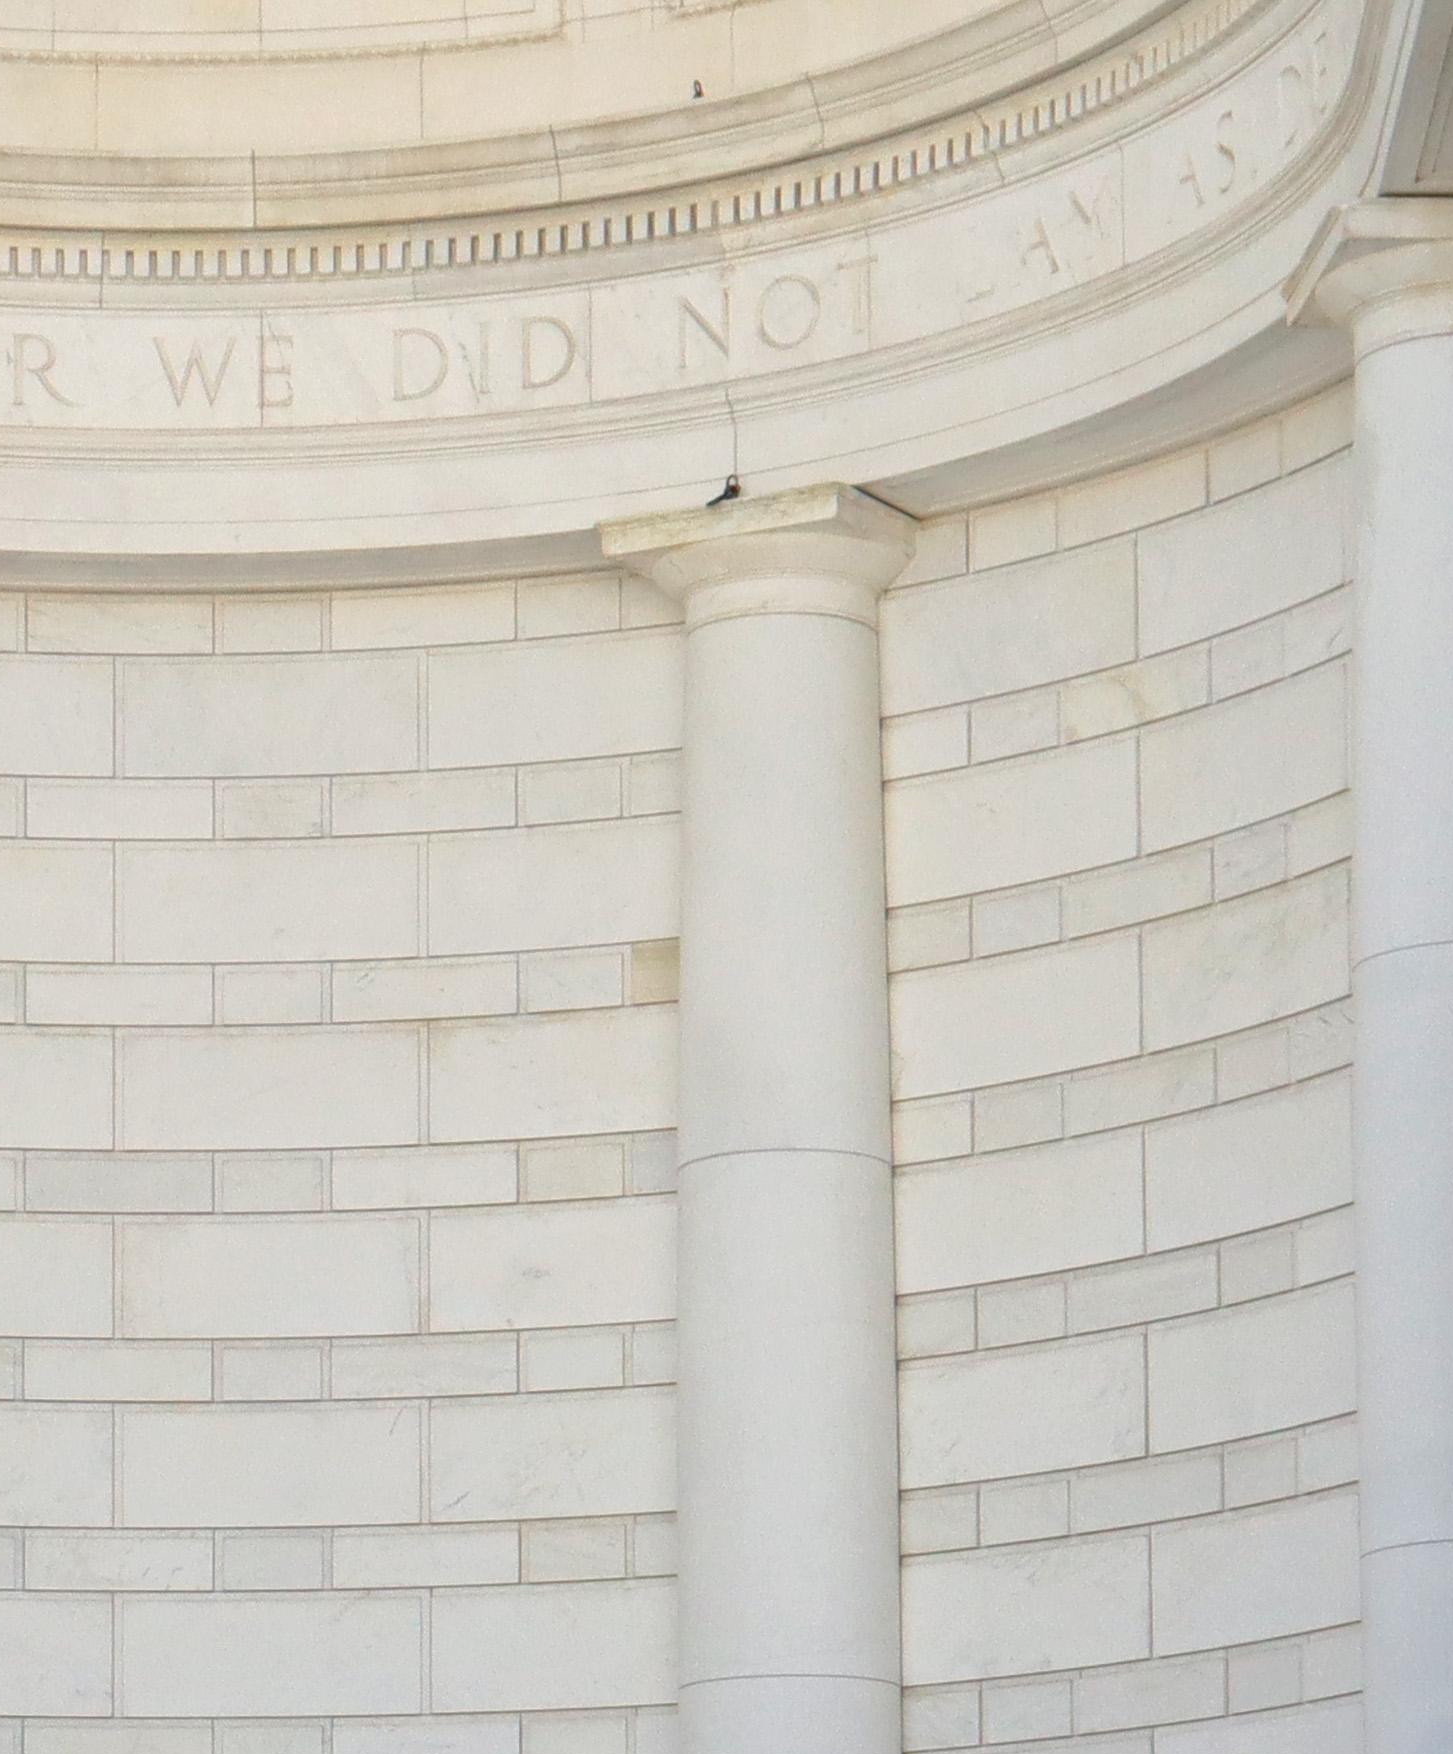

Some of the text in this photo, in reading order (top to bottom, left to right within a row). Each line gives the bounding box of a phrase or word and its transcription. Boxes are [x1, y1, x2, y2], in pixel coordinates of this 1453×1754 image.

[154, 334, 296, 412] WE
[392, 314, 578, 402] DID
[675, 253, 879, 372] NOT
